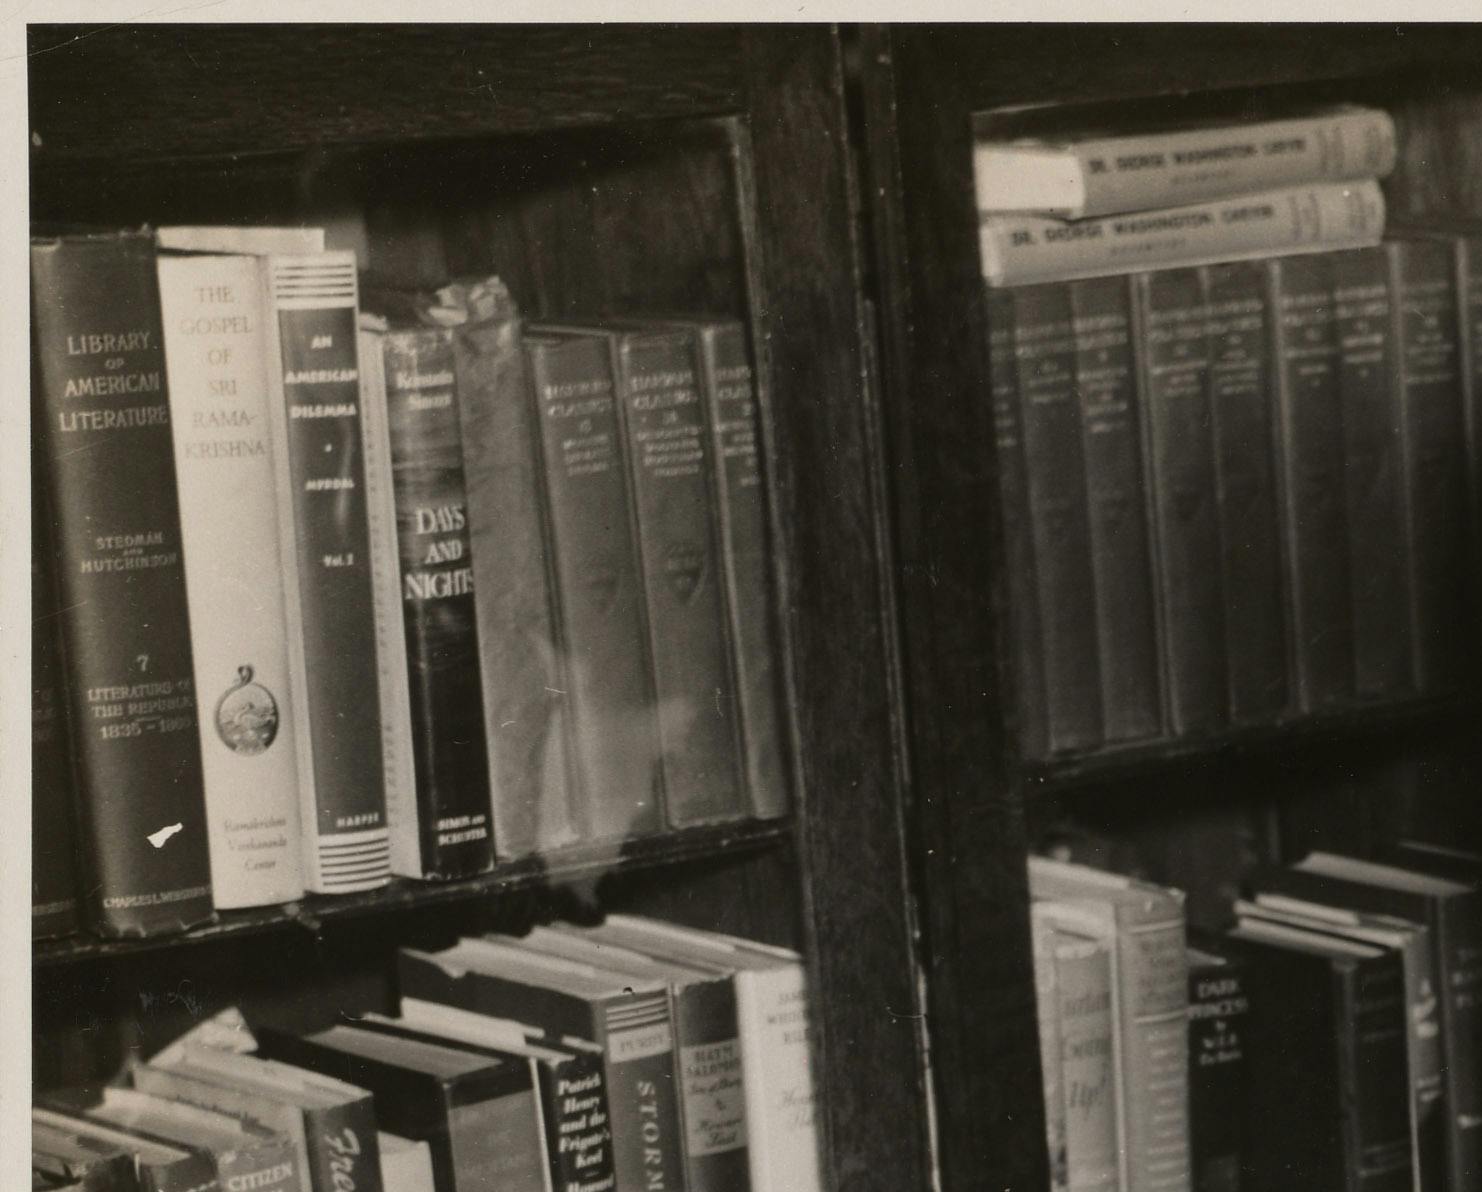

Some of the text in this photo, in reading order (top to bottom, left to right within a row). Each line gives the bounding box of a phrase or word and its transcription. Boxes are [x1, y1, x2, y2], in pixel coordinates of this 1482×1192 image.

[197, 286, 233, 303] THE
[180, 317, 252, 336] GOSPEL
[67, 331, 150, 356] LIBRARY
[311, 335, 332, 349] AN
[208, 348, 232, 366] OF
[64, 372, 160, 398] AMERICAN
[285, 369, 358, 384] AMERICAN
[208, 379, 236, 397] SRI
[58, 404, 168, 432] LITERATURE
[192, 410, 257, 429] RAMA-
[290, 403, 356, 419] DILEMMA
[184, 440, 266, 459] KRISHNA
[416, 504, 466, 534] DAYS
[97, 531, 163, 551] STEDMAN
[425, 540, 462, 564] AND
[81, 553, 177, 573] HUTCHINSON
[91, 705, 124, 718] THE
[560, 1115, 586, 1133] and
[576, 1148, 602, 1168] Keel
[228, 1162, 294, 1192] CITIZEN
